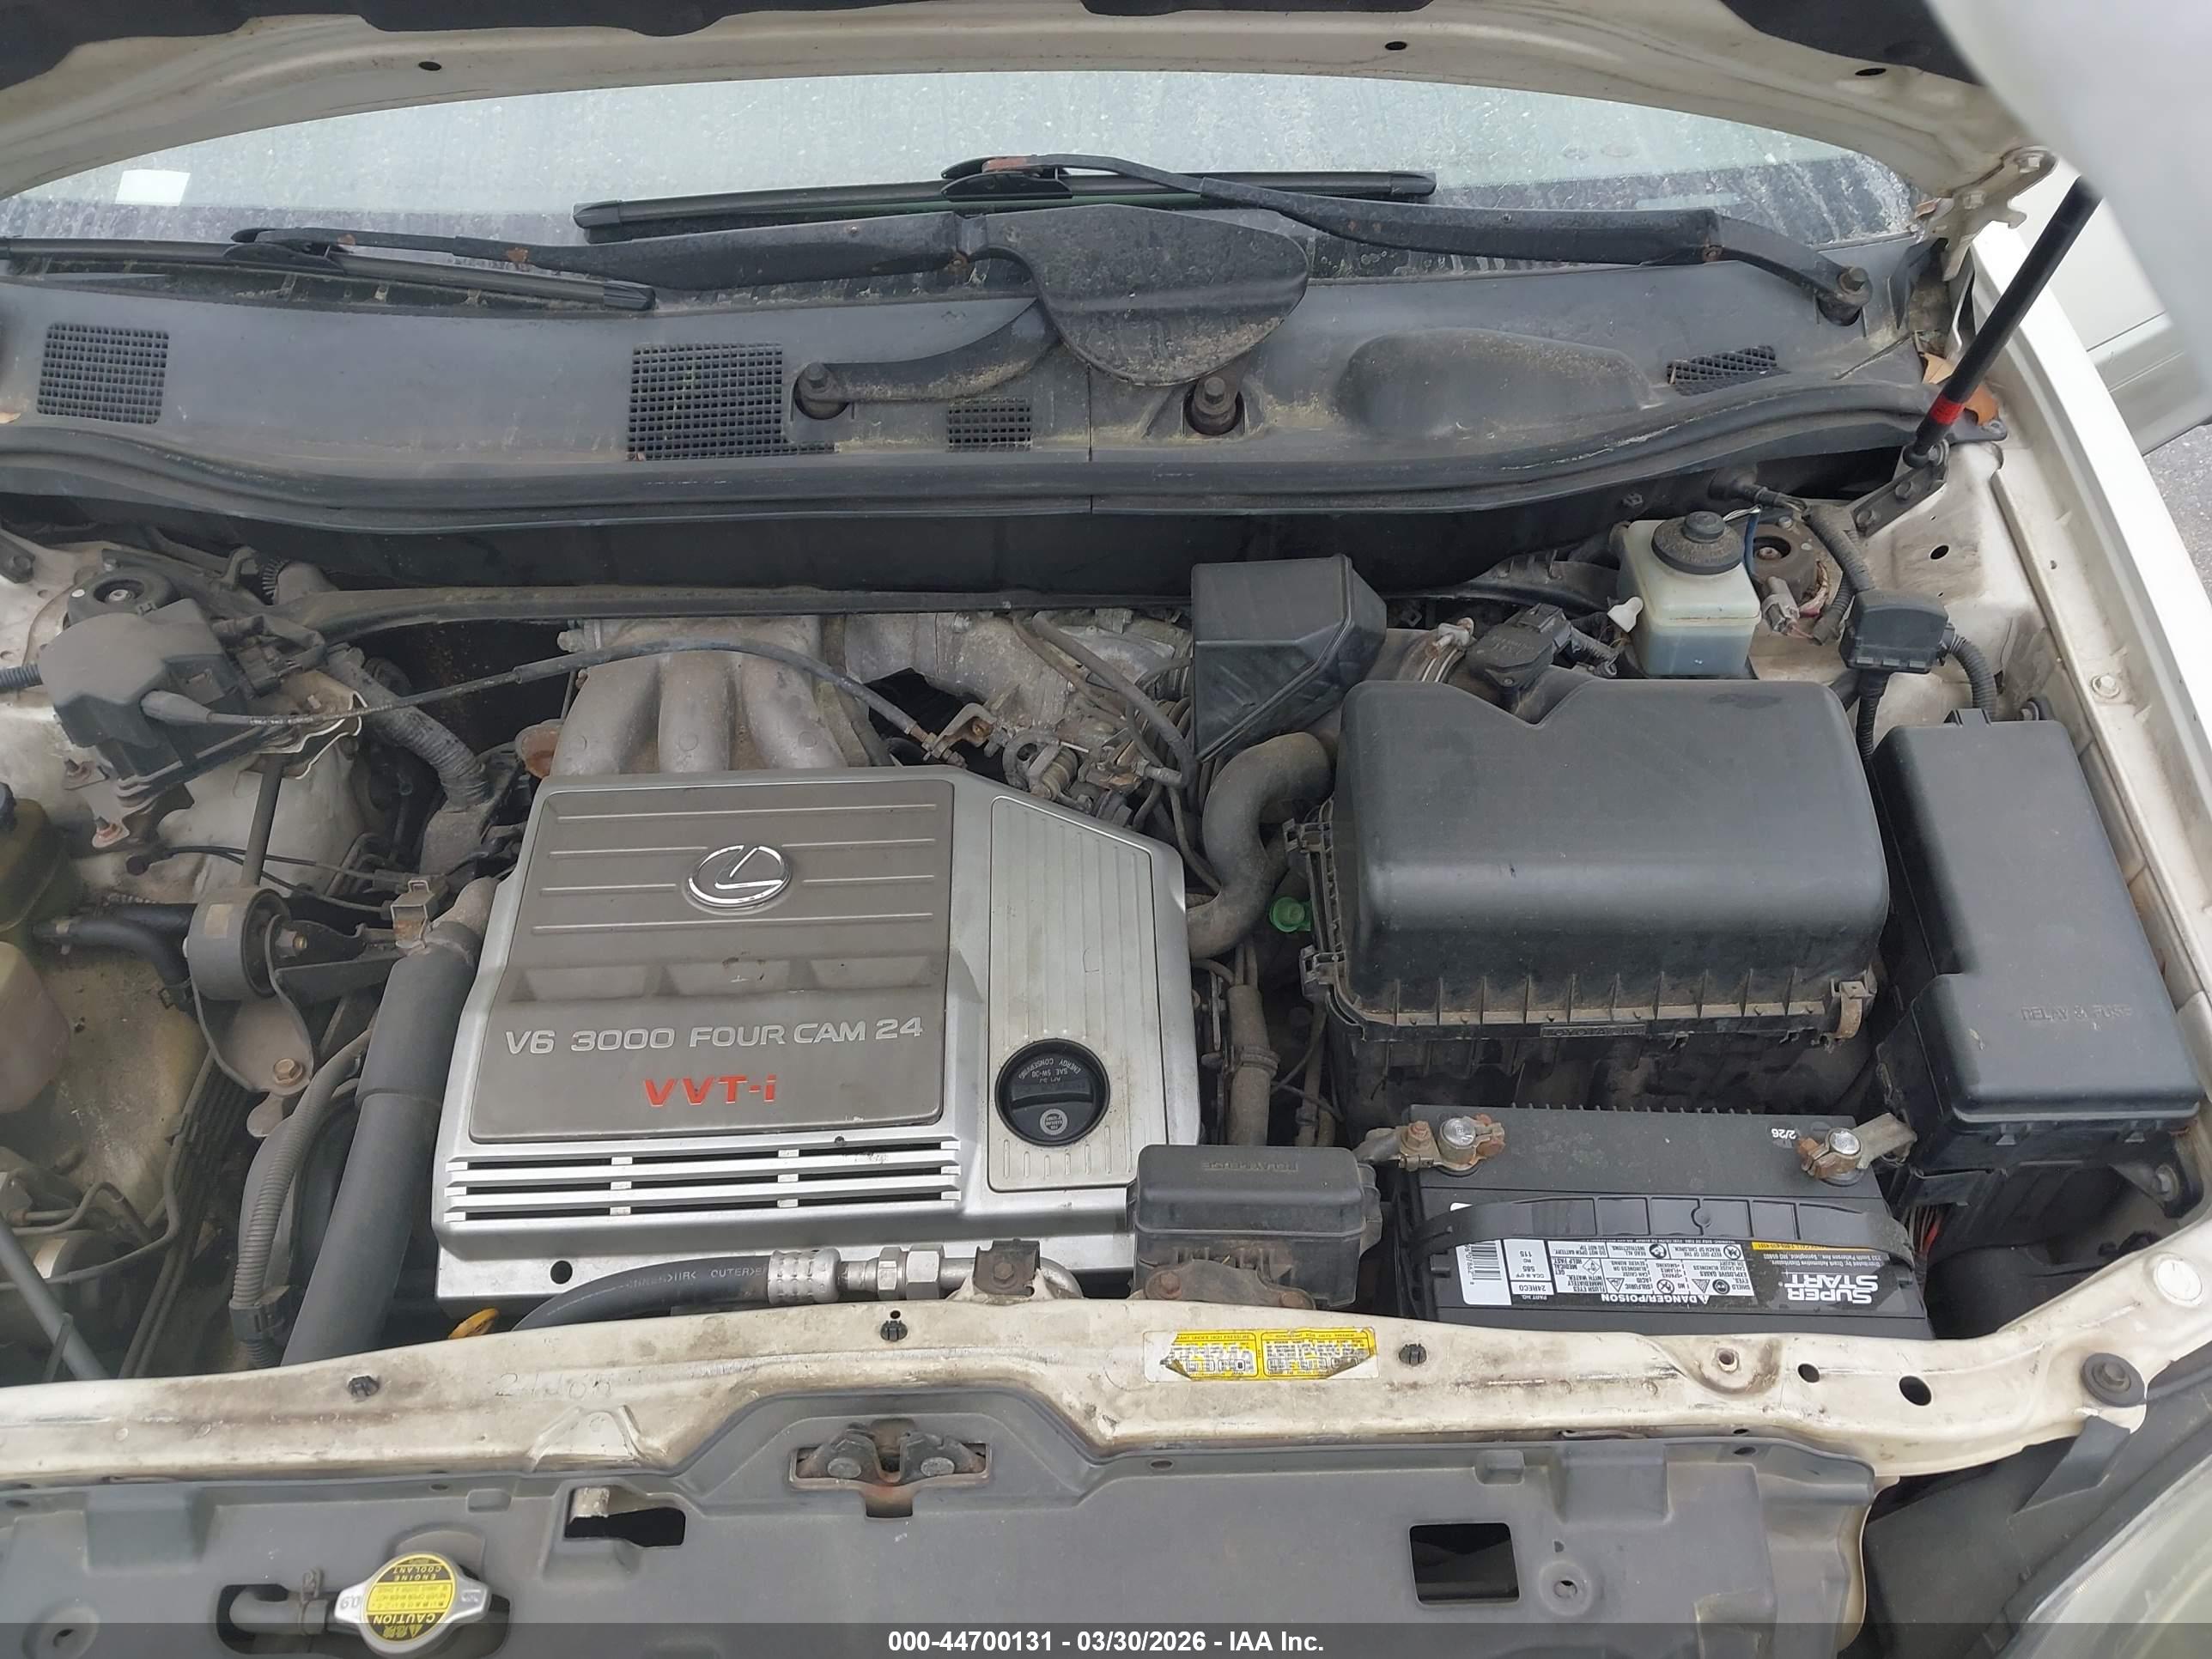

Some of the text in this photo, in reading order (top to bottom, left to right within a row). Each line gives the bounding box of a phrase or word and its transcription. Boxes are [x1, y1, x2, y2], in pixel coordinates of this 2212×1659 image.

[505, 1017, 923, 1054] V6 3000 FOUR CAM 24
[1059, 1059, 1081, 1074] ENERGY
[643, 1074, 777, 1107] VVT-i
[1771, 1128, 1796, 1139] 2/26
[1784, 1274, 1878, 1291] START
[1601, 1294, 1697, 1303] DANGER/POISON
[1788, 1288, 1872, 1304] SUPER
[373, 1613, 435, 1624] CAUTION
